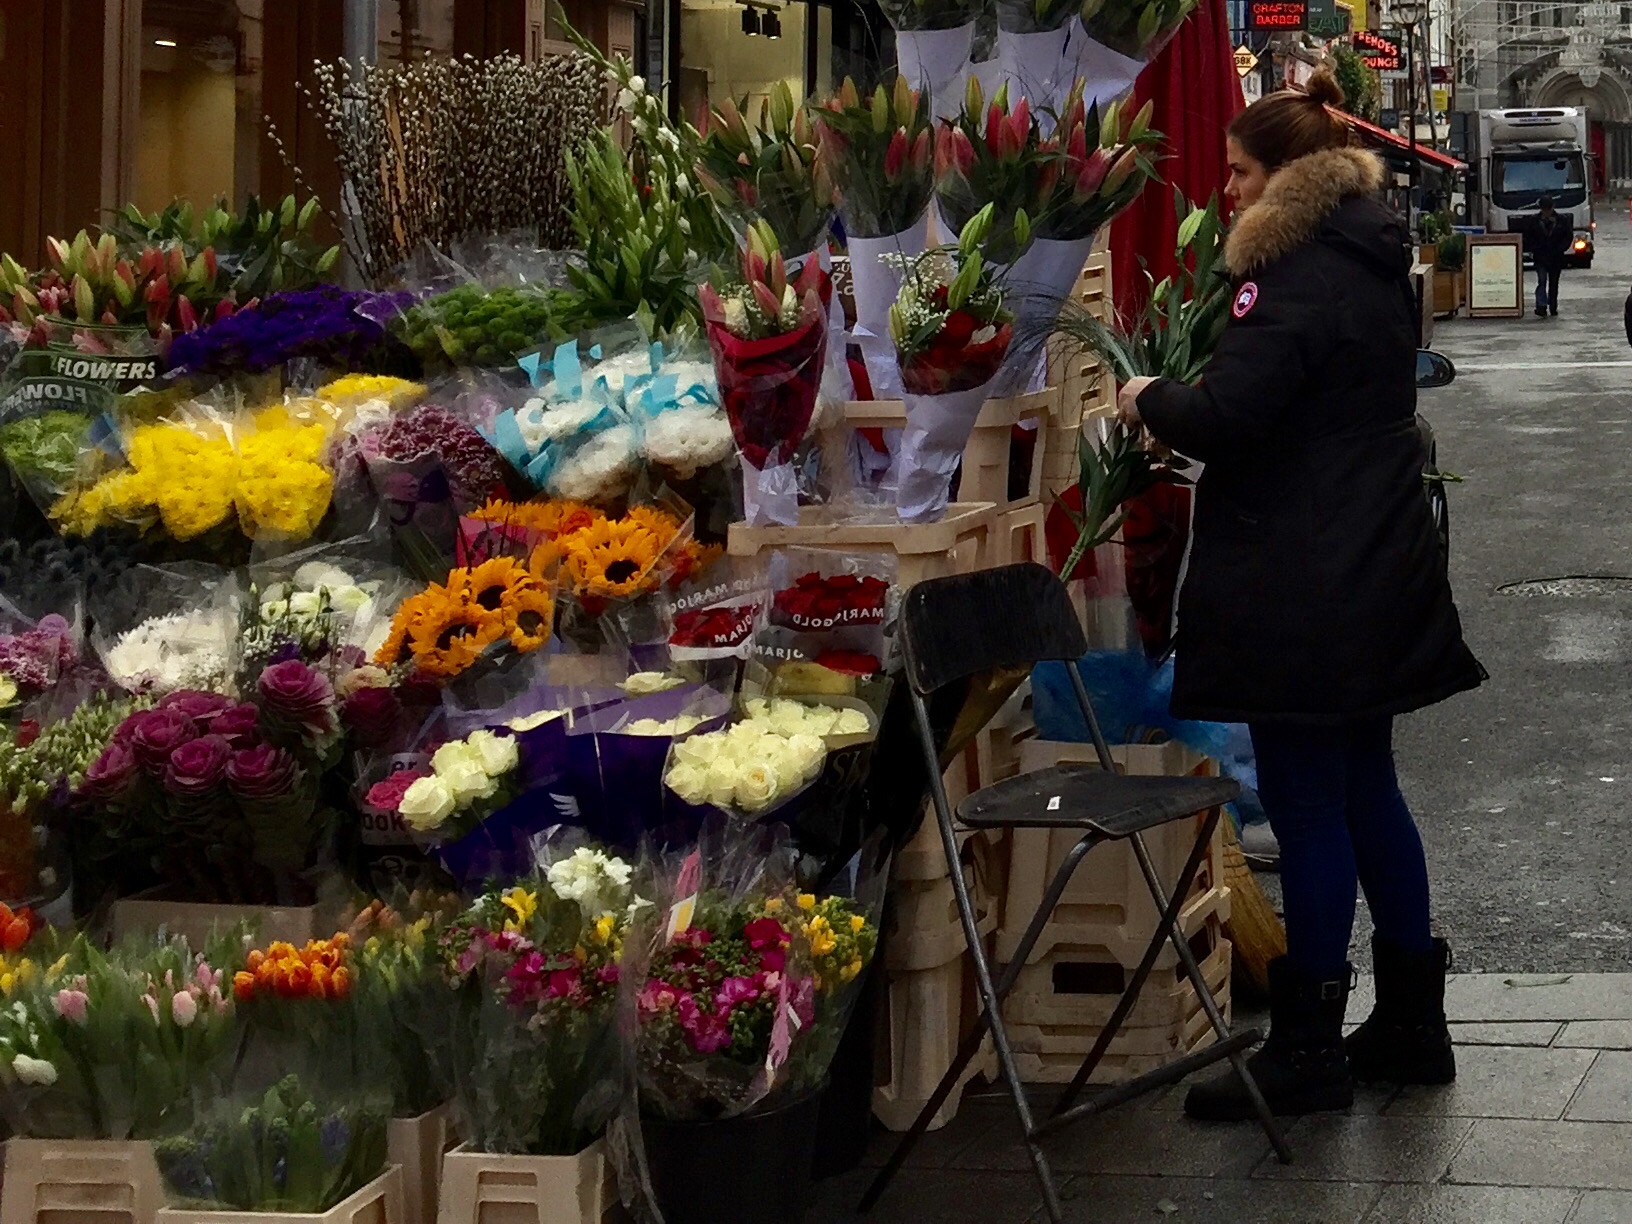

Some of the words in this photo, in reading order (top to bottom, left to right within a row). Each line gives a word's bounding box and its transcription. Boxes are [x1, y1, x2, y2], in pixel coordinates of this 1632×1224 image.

[1252, 3, 1305, 14] GRAFTON
[1362, 57, 1399, 68] OUNGE
[57, 356, 157, 380] FLOWERS
